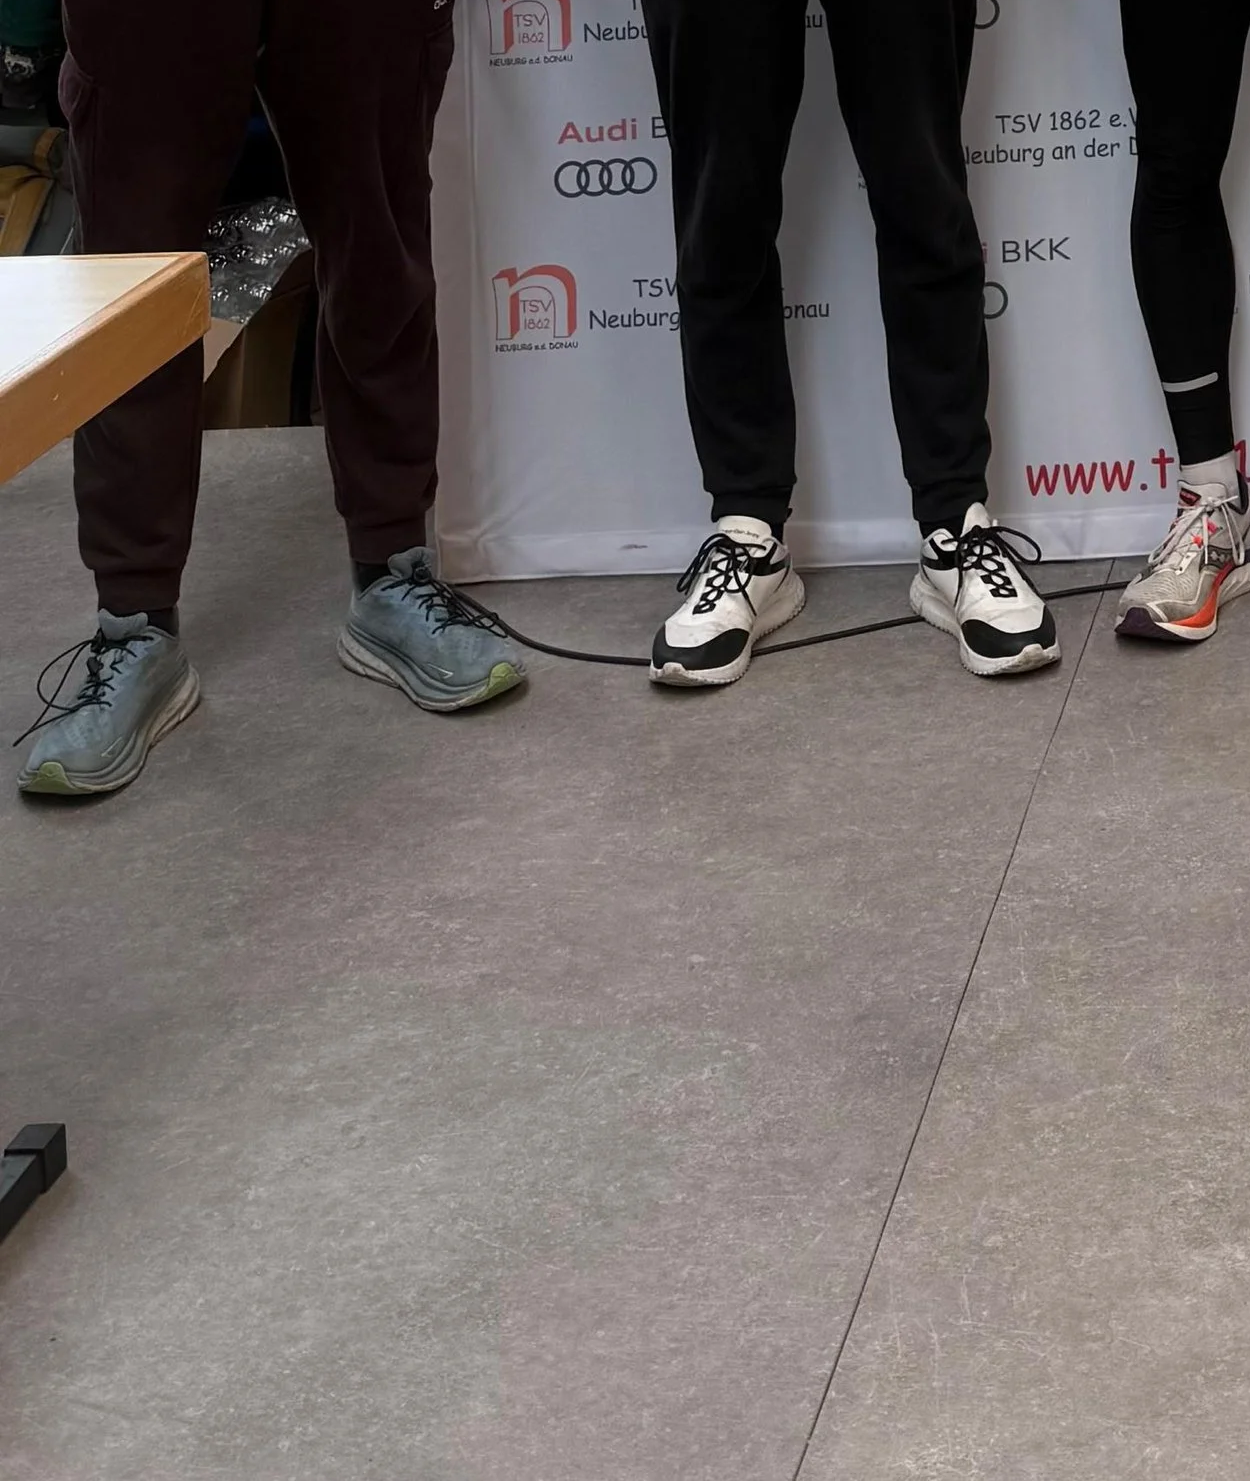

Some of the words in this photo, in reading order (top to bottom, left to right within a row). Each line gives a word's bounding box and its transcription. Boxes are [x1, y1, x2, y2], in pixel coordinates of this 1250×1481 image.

[513, 13, 547, 27] TSV
[517, 31, 545, 44] 1862
[583, 22, 649, 44] Neubu
[543, 54, 573, 64] DONAU
[995, 112, 1042, 134] TSV
[1049, 109, 1101, 132] 1862
[1109, 106, 1138, 129] e.V
[557, 118, 638, 145] Audi
[1051, 145, 1076, 161] an
[1083, 137, 1120, 159] der
[1001, 236, 1071, 264] BKK
[632, 277, 679, 299] TSV
[519, 298, 554, 313] TSV
[783, 302, 830, 320] onau
[522, 317, 550, 330] 1862
[588, 309, 681, 332] Neuburg
[547, 340, 579, 351] DONAU
